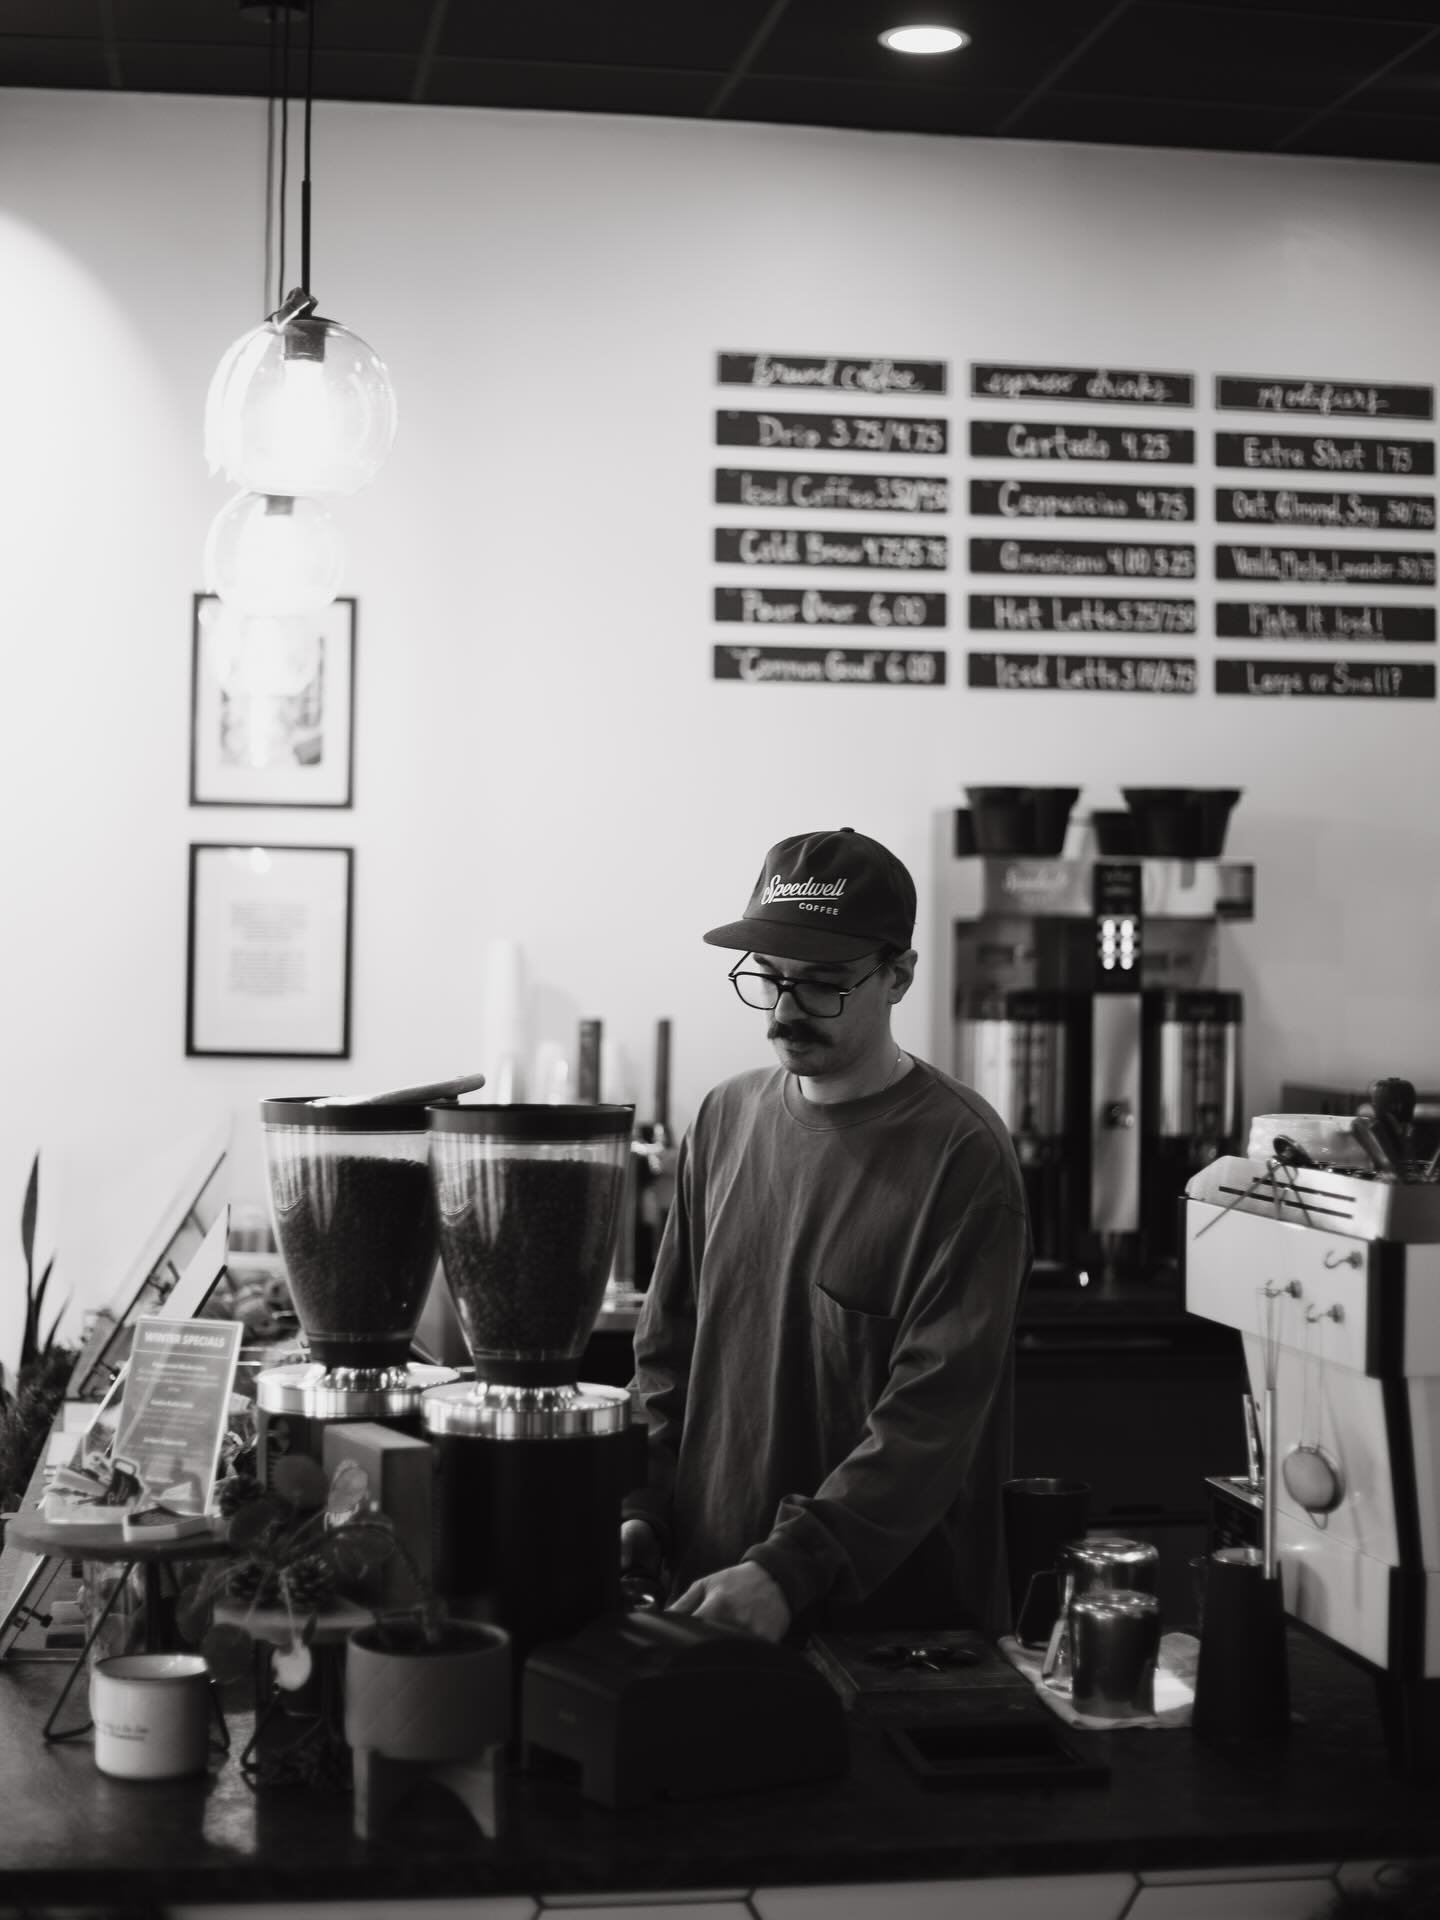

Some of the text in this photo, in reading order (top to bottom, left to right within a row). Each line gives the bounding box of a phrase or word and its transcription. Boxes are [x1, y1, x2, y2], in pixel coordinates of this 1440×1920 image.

[1008, 424, 1111, 460] Cortado
[1243, 437, 1305, 468] Extra
[1312, 439, 1366, 470] Shot
[739, 530, 799, 564] Cold
[741, 590, 799, 623] Pour
[802, 591, 857, 624] Over
[993, 597, 1043, 630] Hot
[1052, 598, 1118, 632] Latte
[996, 655, 1049, 687] Iced
[1056, 656, 1120, 689] Latte
[1246, 661, 1403, 698] Large or Small?
[761, 874, 848, 905] Speedwell
[798, 902, 840, 916] COFFEE
[144, 1331, 225, 1349] WINTER SPECIALS
